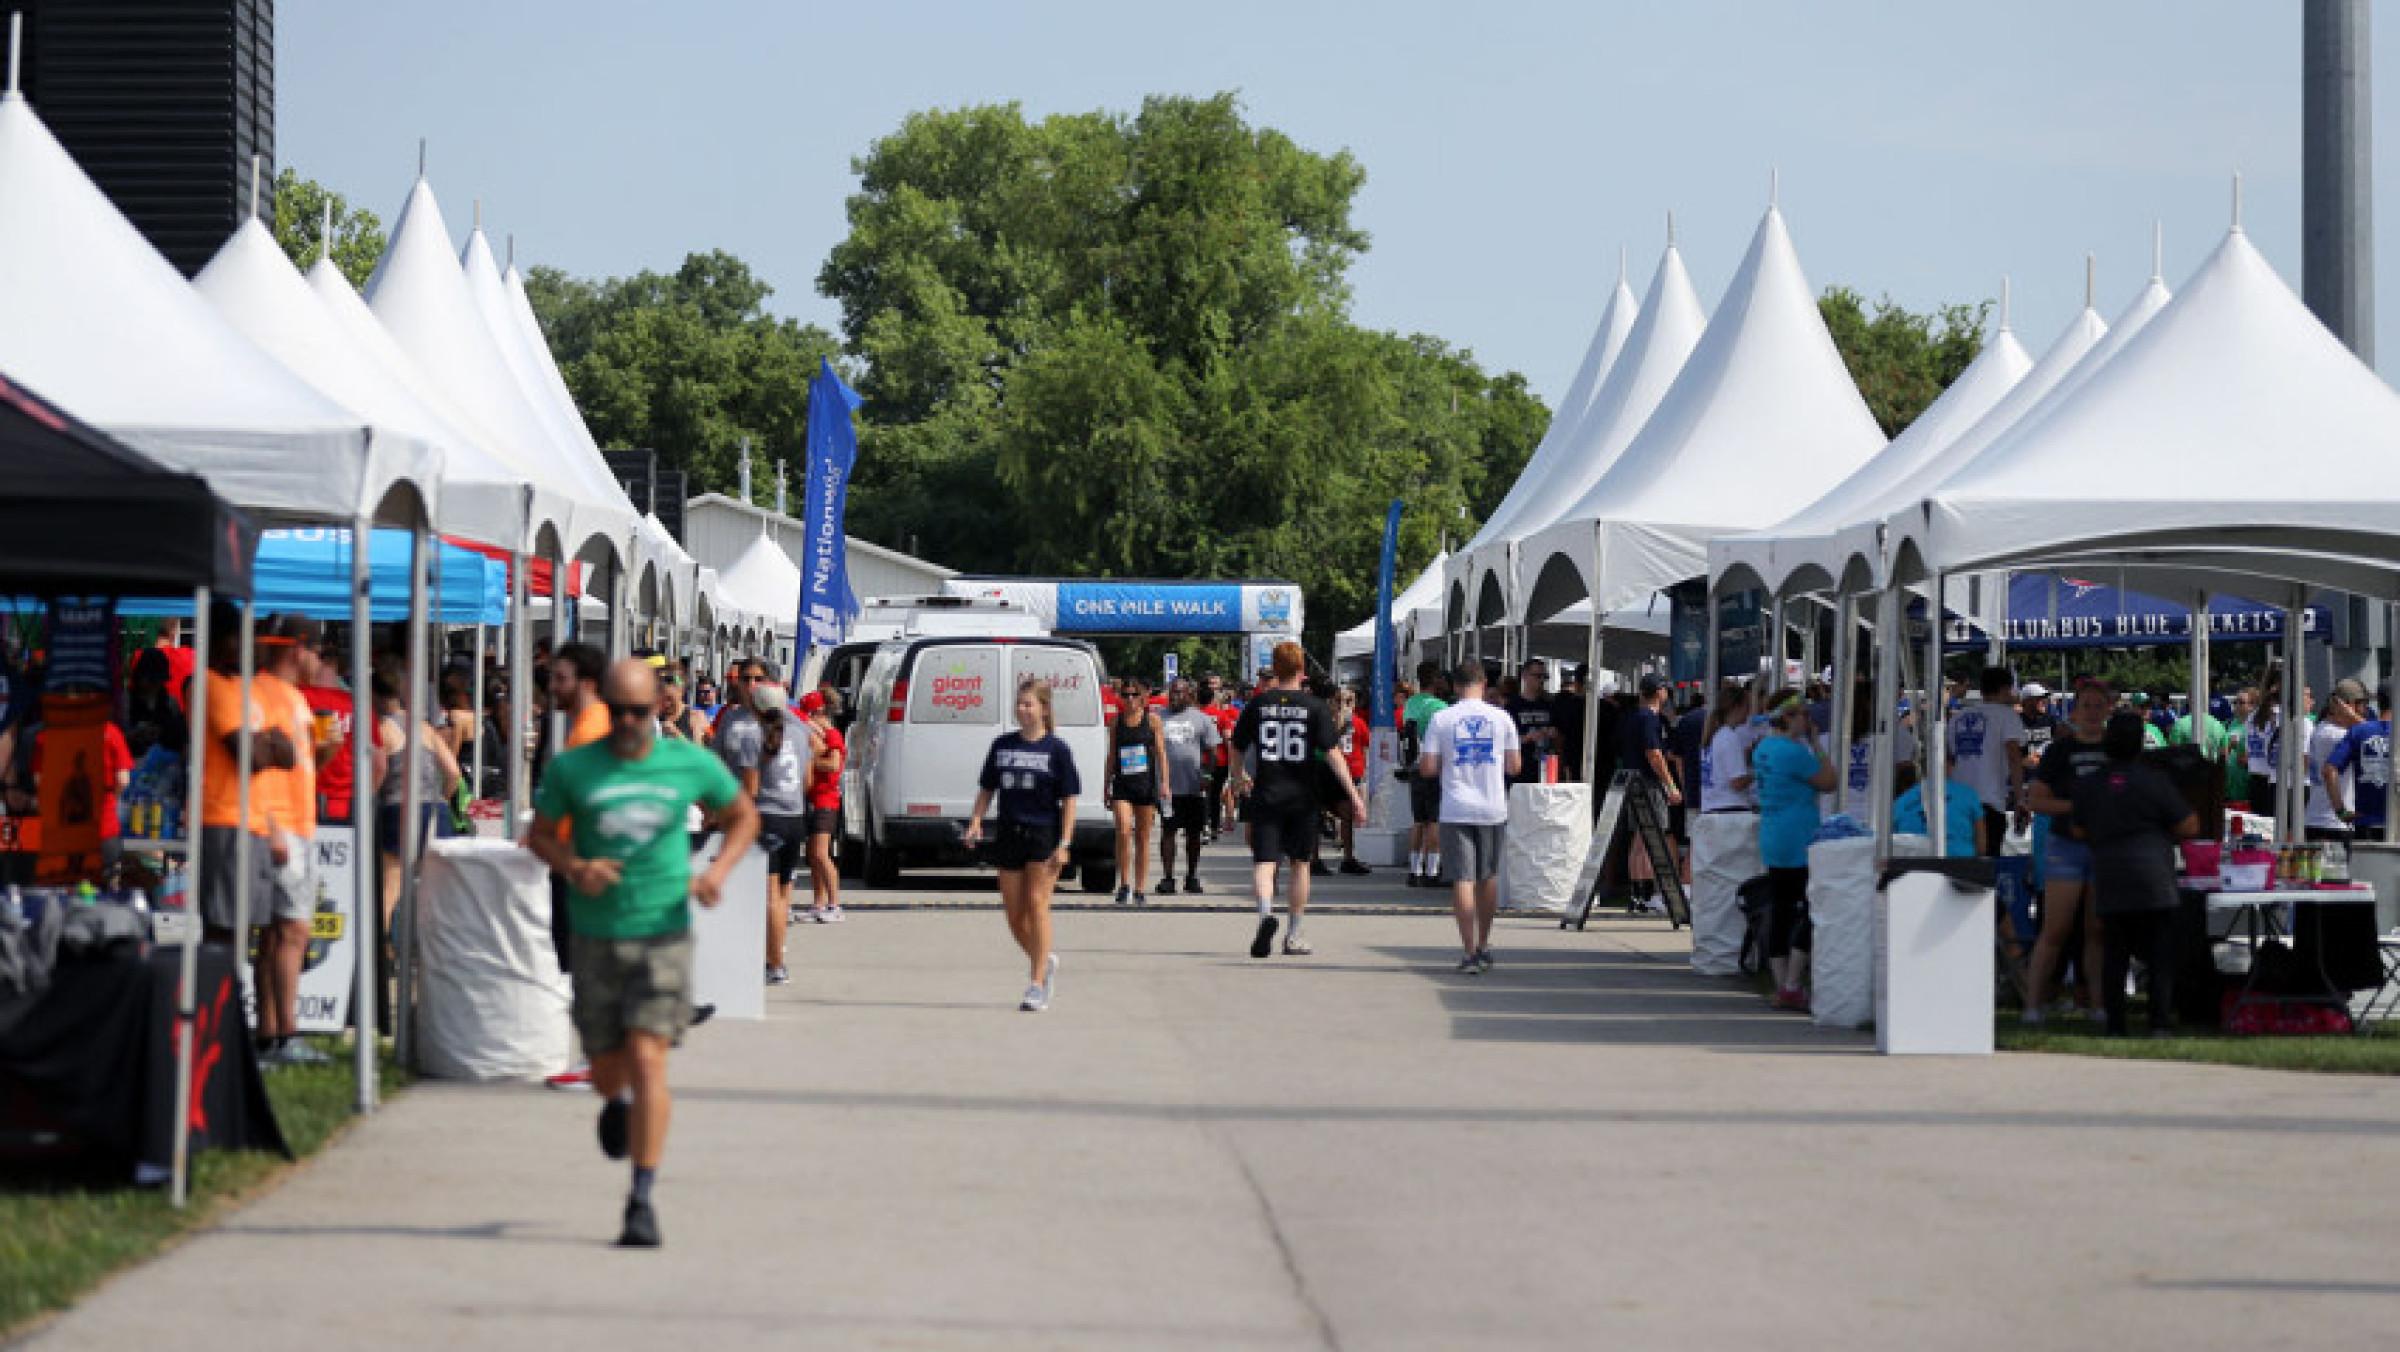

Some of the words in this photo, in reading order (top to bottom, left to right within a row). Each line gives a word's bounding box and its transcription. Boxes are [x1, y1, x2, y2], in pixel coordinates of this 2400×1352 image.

[1075, 599, 1115, 615] ONE
[1121, 599, 1164, 615] MILE
[1171, 599, 1226, 615] WALK
[1999, 616, 2103, 640] OLUMBUS
[2115, 612, 2170, 637] BLUE
[2182, 609, 2278, 635] JCKETS
[932, 675, 984, 694] giant
[932, 691, 984, 711] eagle
[1259, 721, 1307, 761] 96
